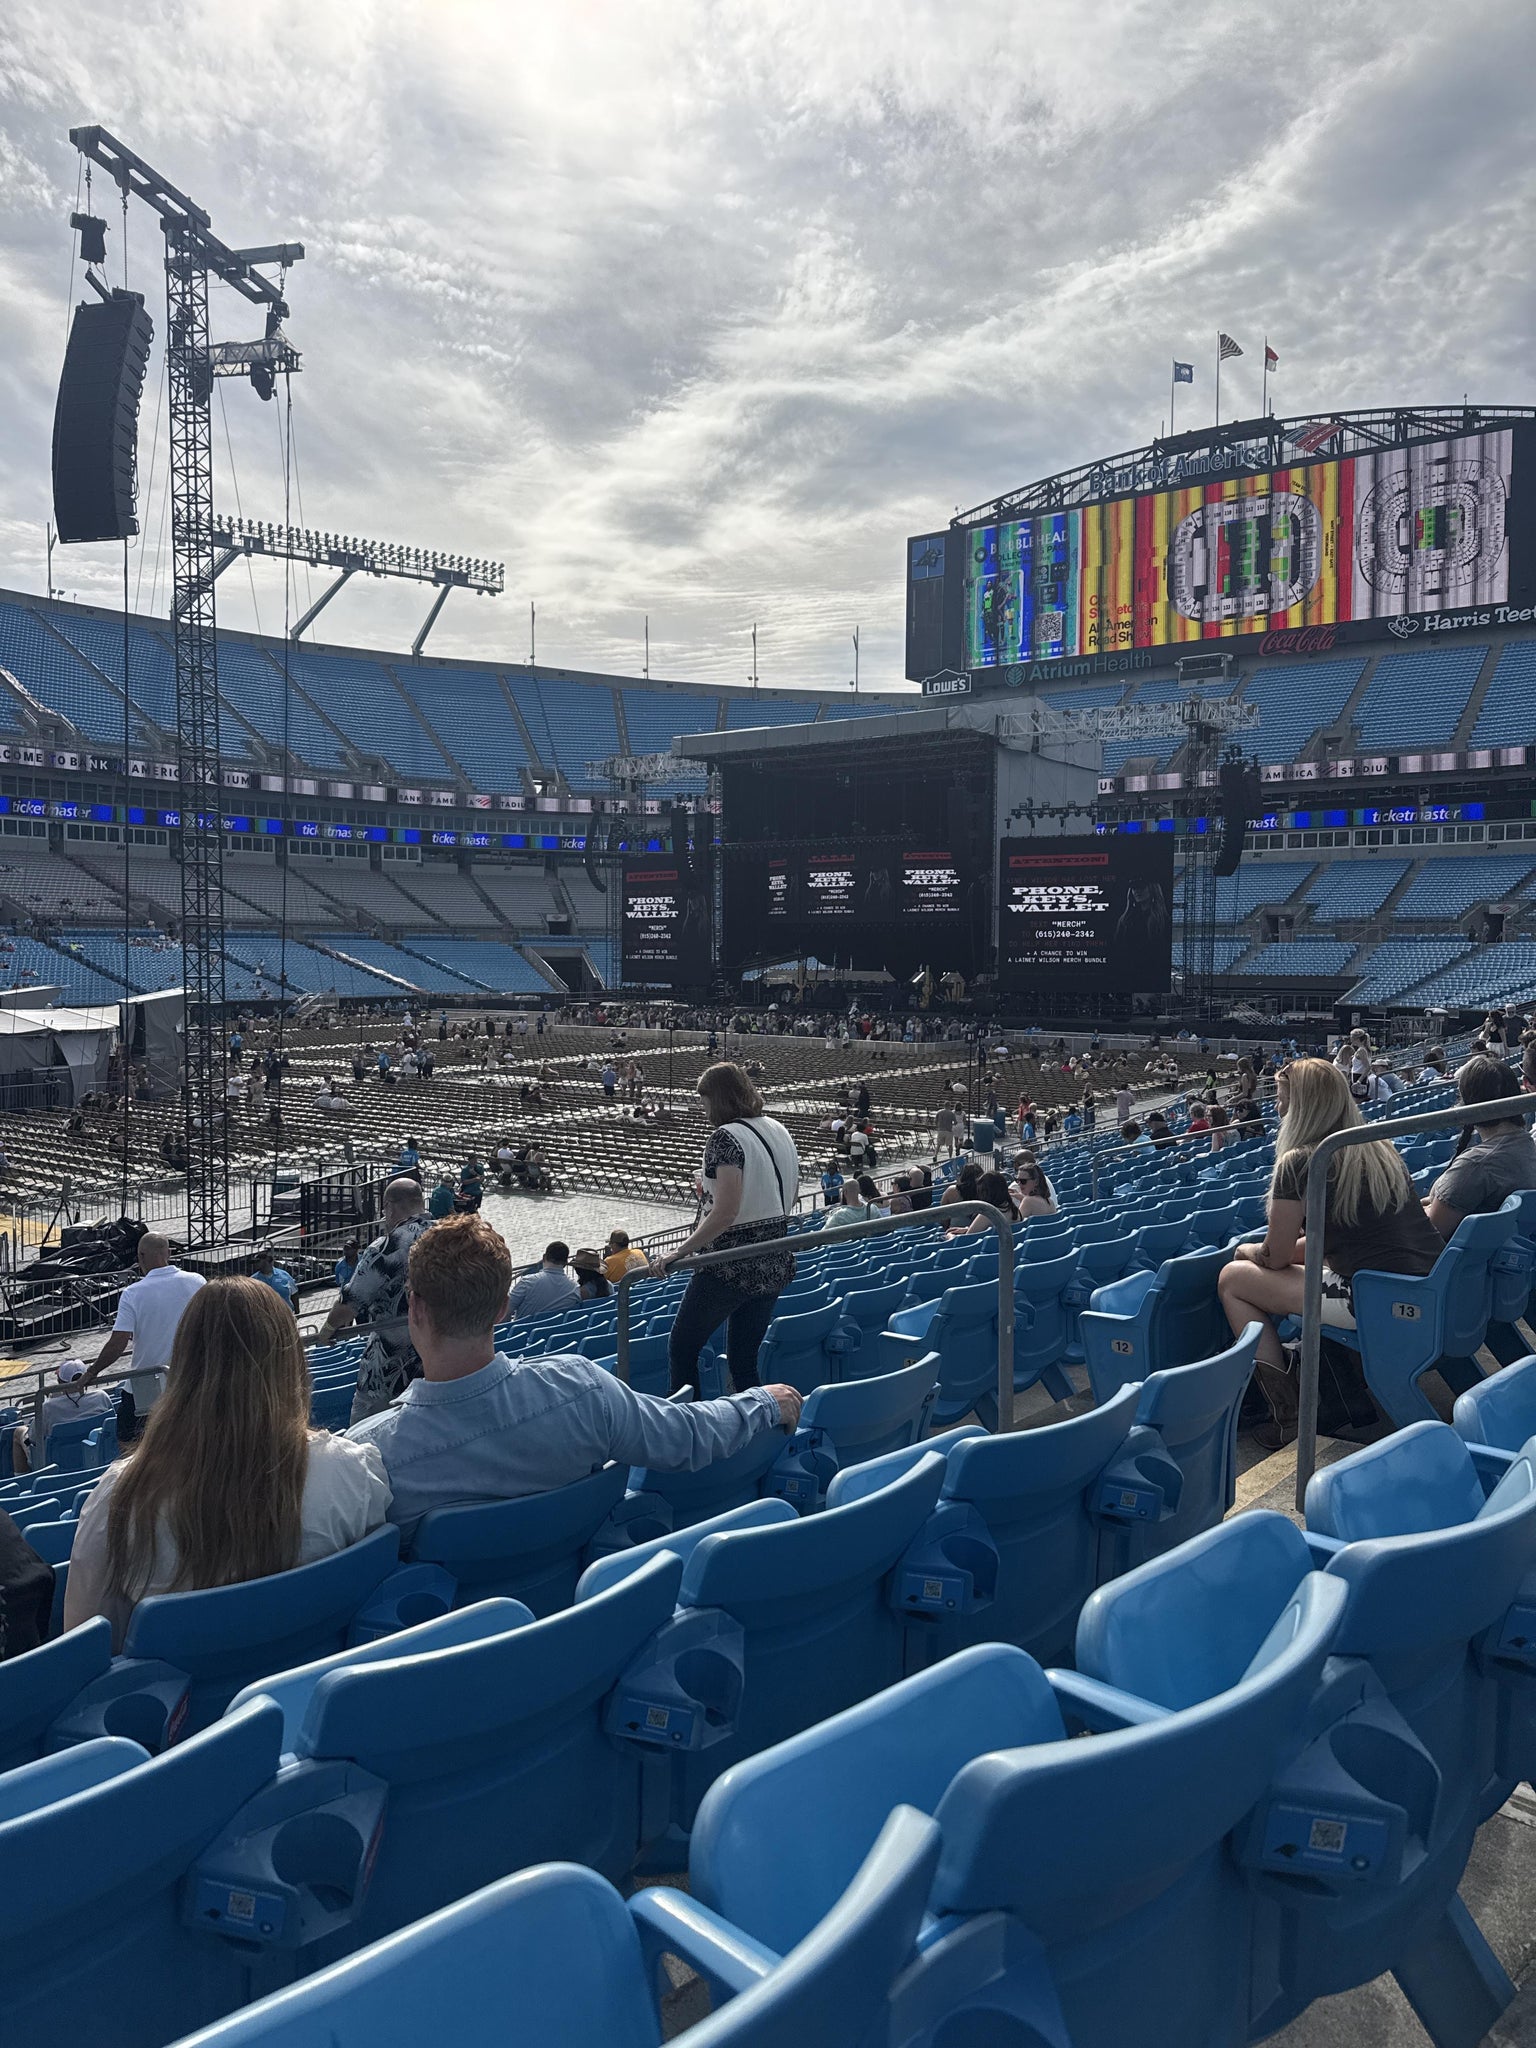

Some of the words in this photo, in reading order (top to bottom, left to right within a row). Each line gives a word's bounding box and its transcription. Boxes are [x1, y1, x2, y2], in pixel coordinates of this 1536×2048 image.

[1089, 464, 1145, 495] Bank
[1148, 460, 1170, 483] of
[1173, 442, 1270, 478] America
[990, 530, 1068, 554] BBBLEHEAD
[1424, 611, 1490, 632] Harris
[1028, 661, 1091, 682] Atrium
[1094, 651, 1152, 673] Health
[926, 679, 966, 695] LOWE'S
[0, 749, 43, 763] COME
[70, 757, 108, 770] BANK
[132, 764, 181, 778] AMERIC
[1265, 769, 1313, 780] AMERICA
[12, 800, 91, 818] ticketmaster
[1372, 808, 1460, 823] ticketmaster
[1012, 886, 1103, 895] PHONE,
[1022, 894, 1092, 904] KEYS,
[1007, 903, 1110, 913] WALLET
[1399, 1304, 1414, 1318] 13
[1116, 1341, 1129, 1352] 12
